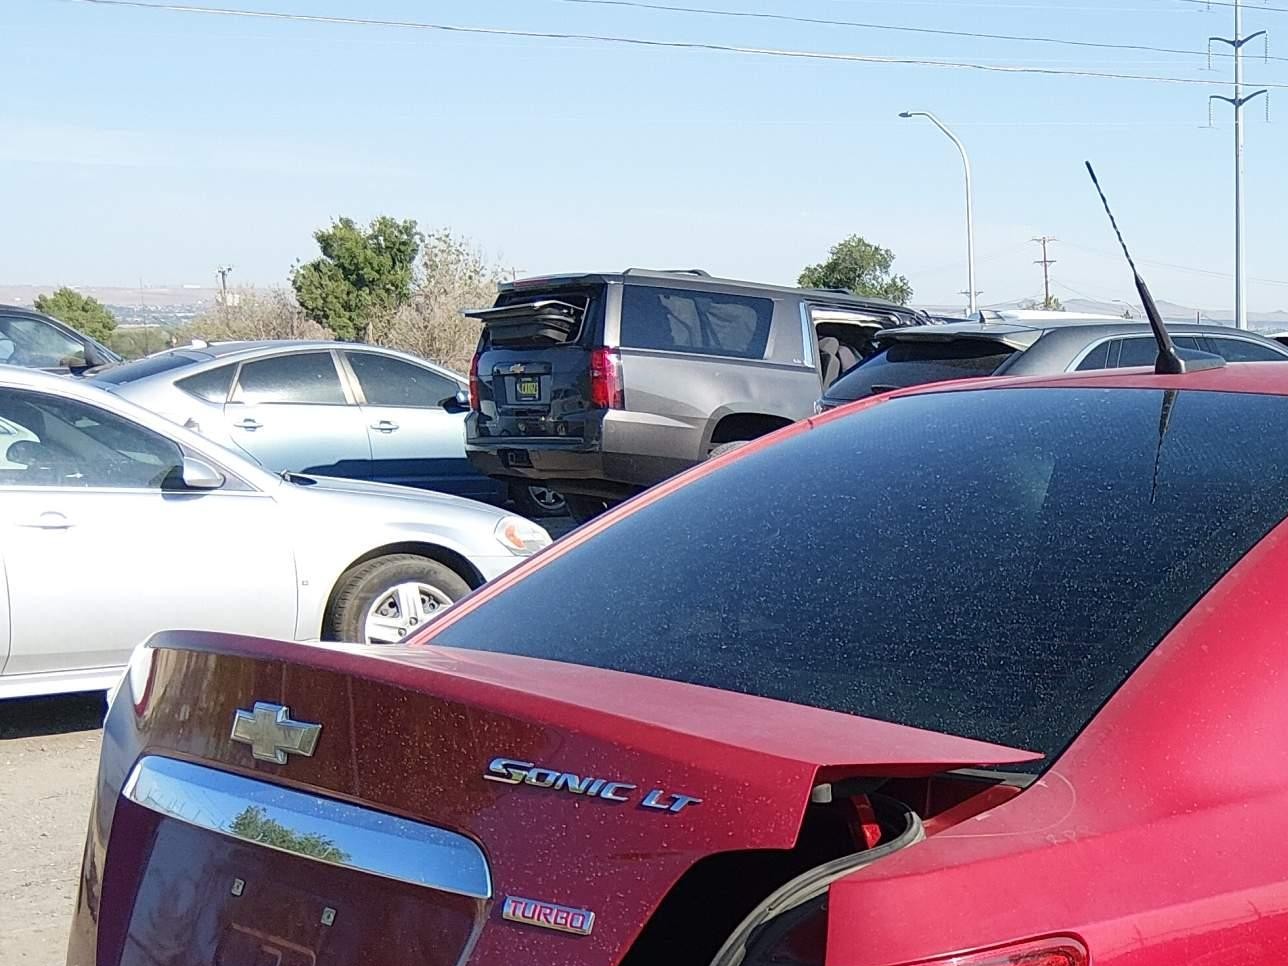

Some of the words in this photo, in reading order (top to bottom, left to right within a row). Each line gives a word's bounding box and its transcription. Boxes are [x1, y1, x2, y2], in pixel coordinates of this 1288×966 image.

[483, 757, 637, 801] SONIC
[642, 789, 704, 812] LT
[508, 899, 588, 930] TURBO
